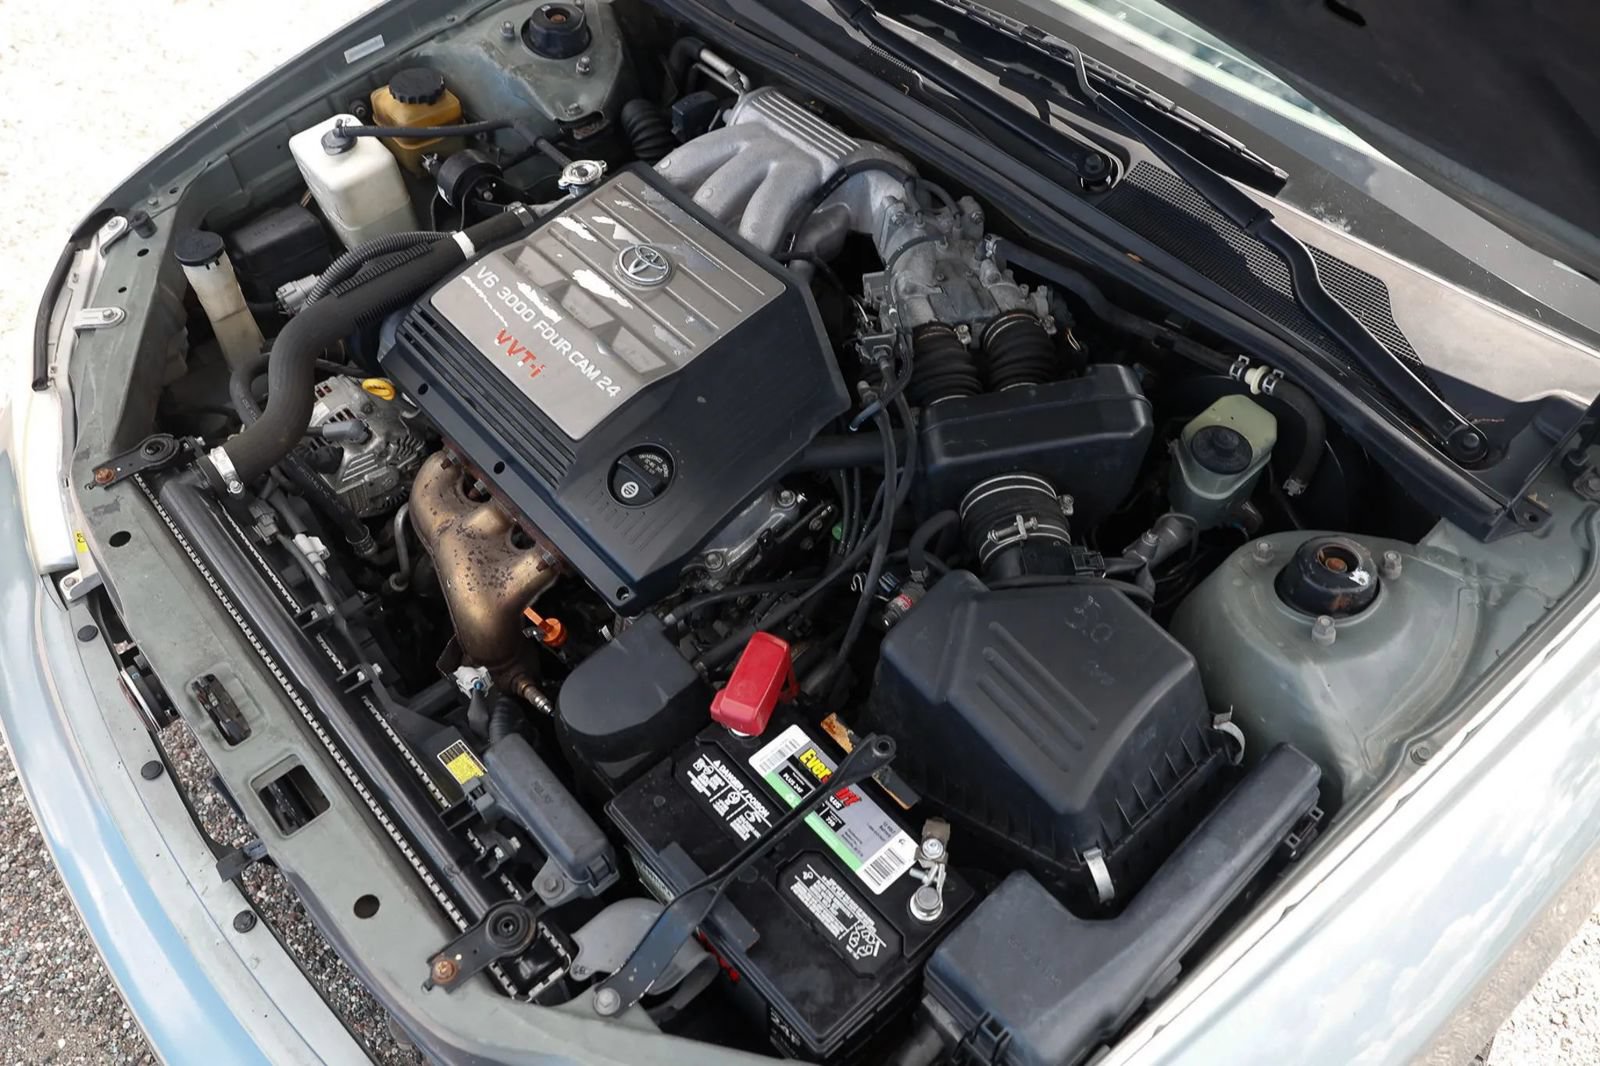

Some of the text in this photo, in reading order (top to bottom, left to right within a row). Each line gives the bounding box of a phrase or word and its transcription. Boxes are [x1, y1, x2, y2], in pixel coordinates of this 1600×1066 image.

[477, 266, 621, 397] V6 3000 FOUR CAM 24
[494, 327, 546, 379] VVT-i
[718, 764, 745, 791] DANGER
[745, 792, 770, 818] POISON
[782, 772, 795, 787] PLUS
